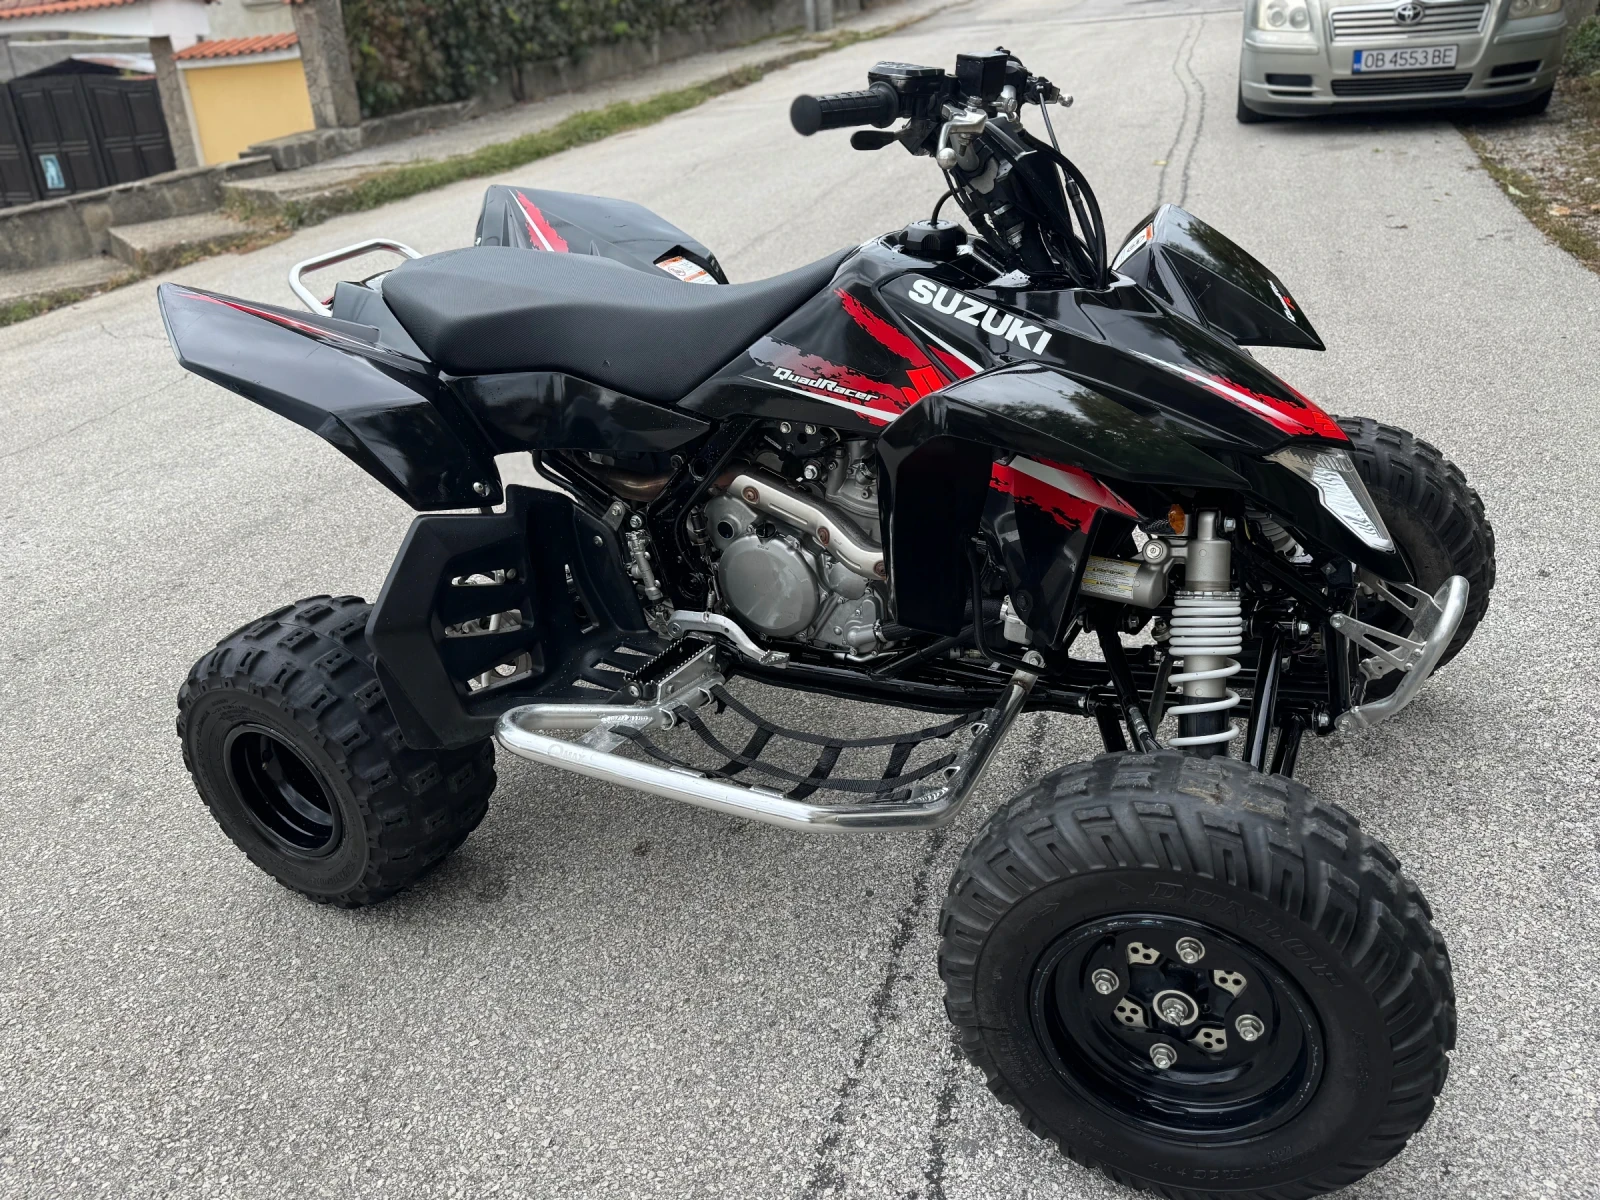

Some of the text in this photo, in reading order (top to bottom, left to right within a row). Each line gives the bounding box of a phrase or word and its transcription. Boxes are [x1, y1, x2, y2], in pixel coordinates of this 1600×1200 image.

[1389, 50, 1429, 67] 4553
[1431, 48, 1454, 65] BE
[908, 279, 1052, 356] SUZUKI
[773, 366, 879, 402] QuadRacer
[1148, 881, 1343, 988] DUNLOP
